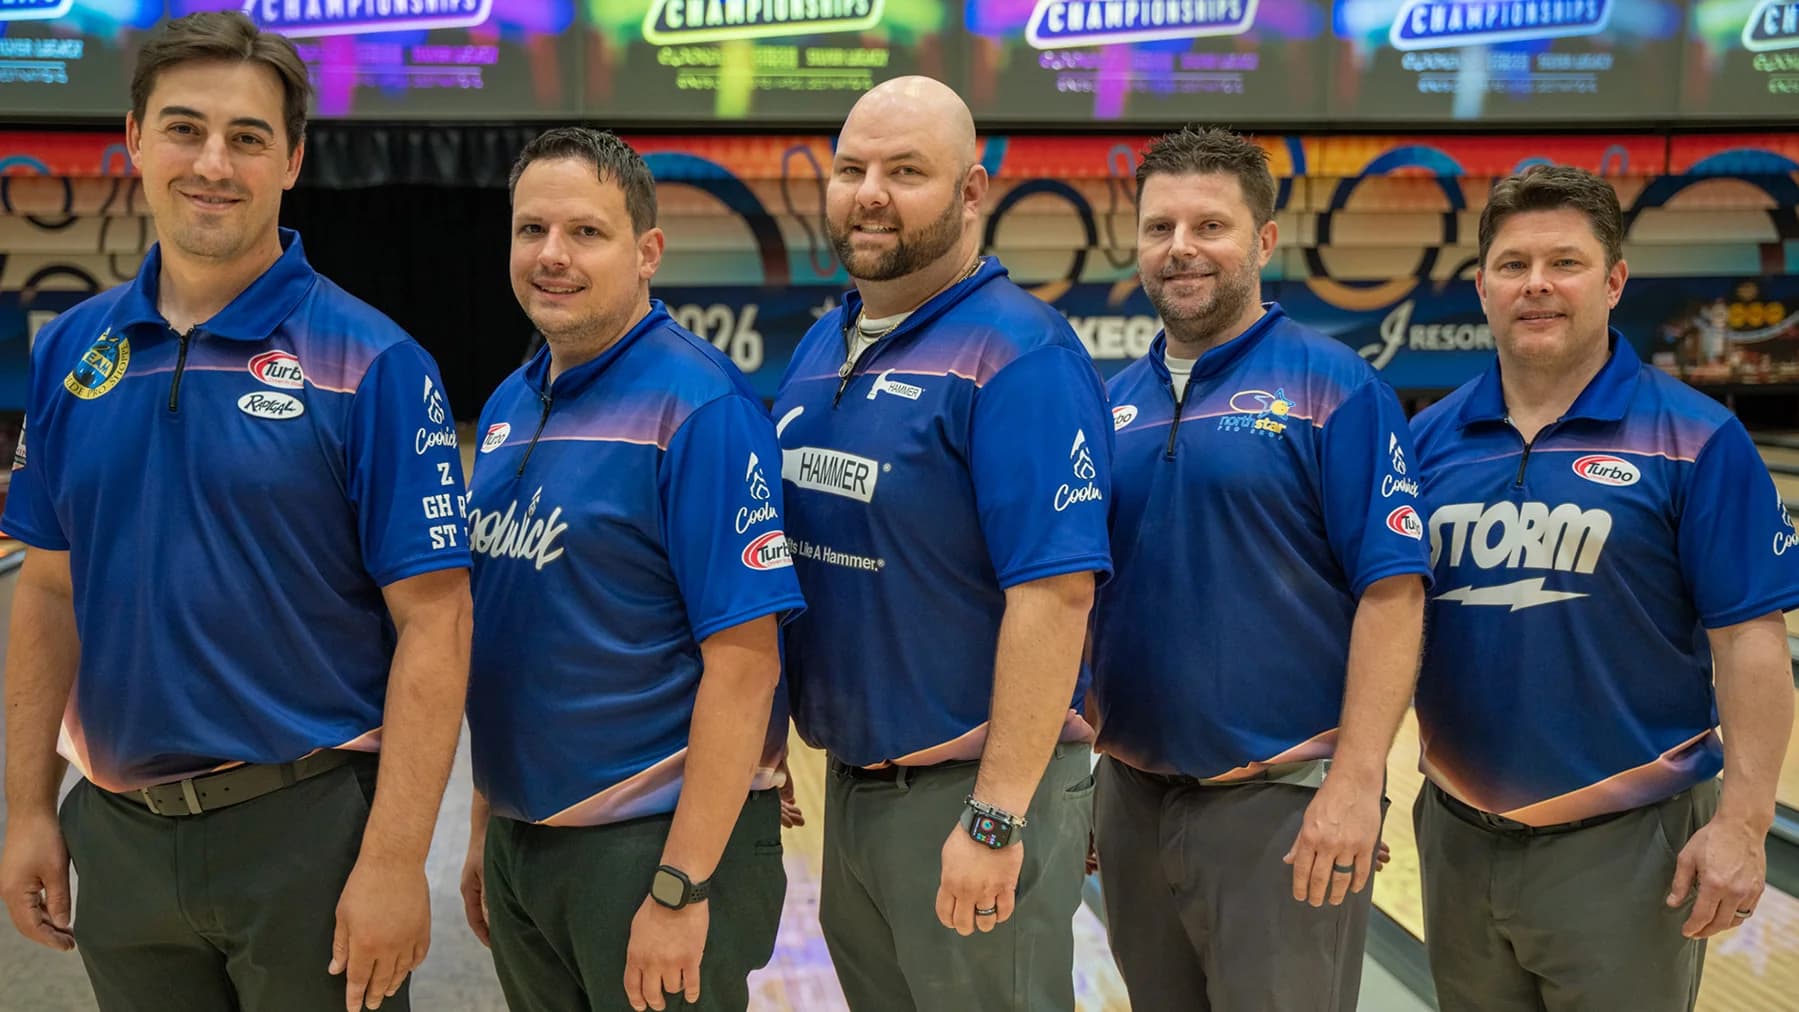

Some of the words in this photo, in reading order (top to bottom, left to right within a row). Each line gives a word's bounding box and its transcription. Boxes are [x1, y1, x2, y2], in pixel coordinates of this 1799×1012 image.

[1047, 0, 1243, 32] CHAMPIONSHIPS
[1411, 1, 1598, 34] CHAMPIONSHIPS
[666, 303, 764, 373] 026
[1409, 324, 1497, 350] RESOR
[264, 361, 302, 381] Turb
[888, 383, 920, 397] HAMMER
[799, 452, 870, 495] HAMMER
[1587, 462, 1633, 482] Turbo
[1428, 500, 1612, 574] STORM
